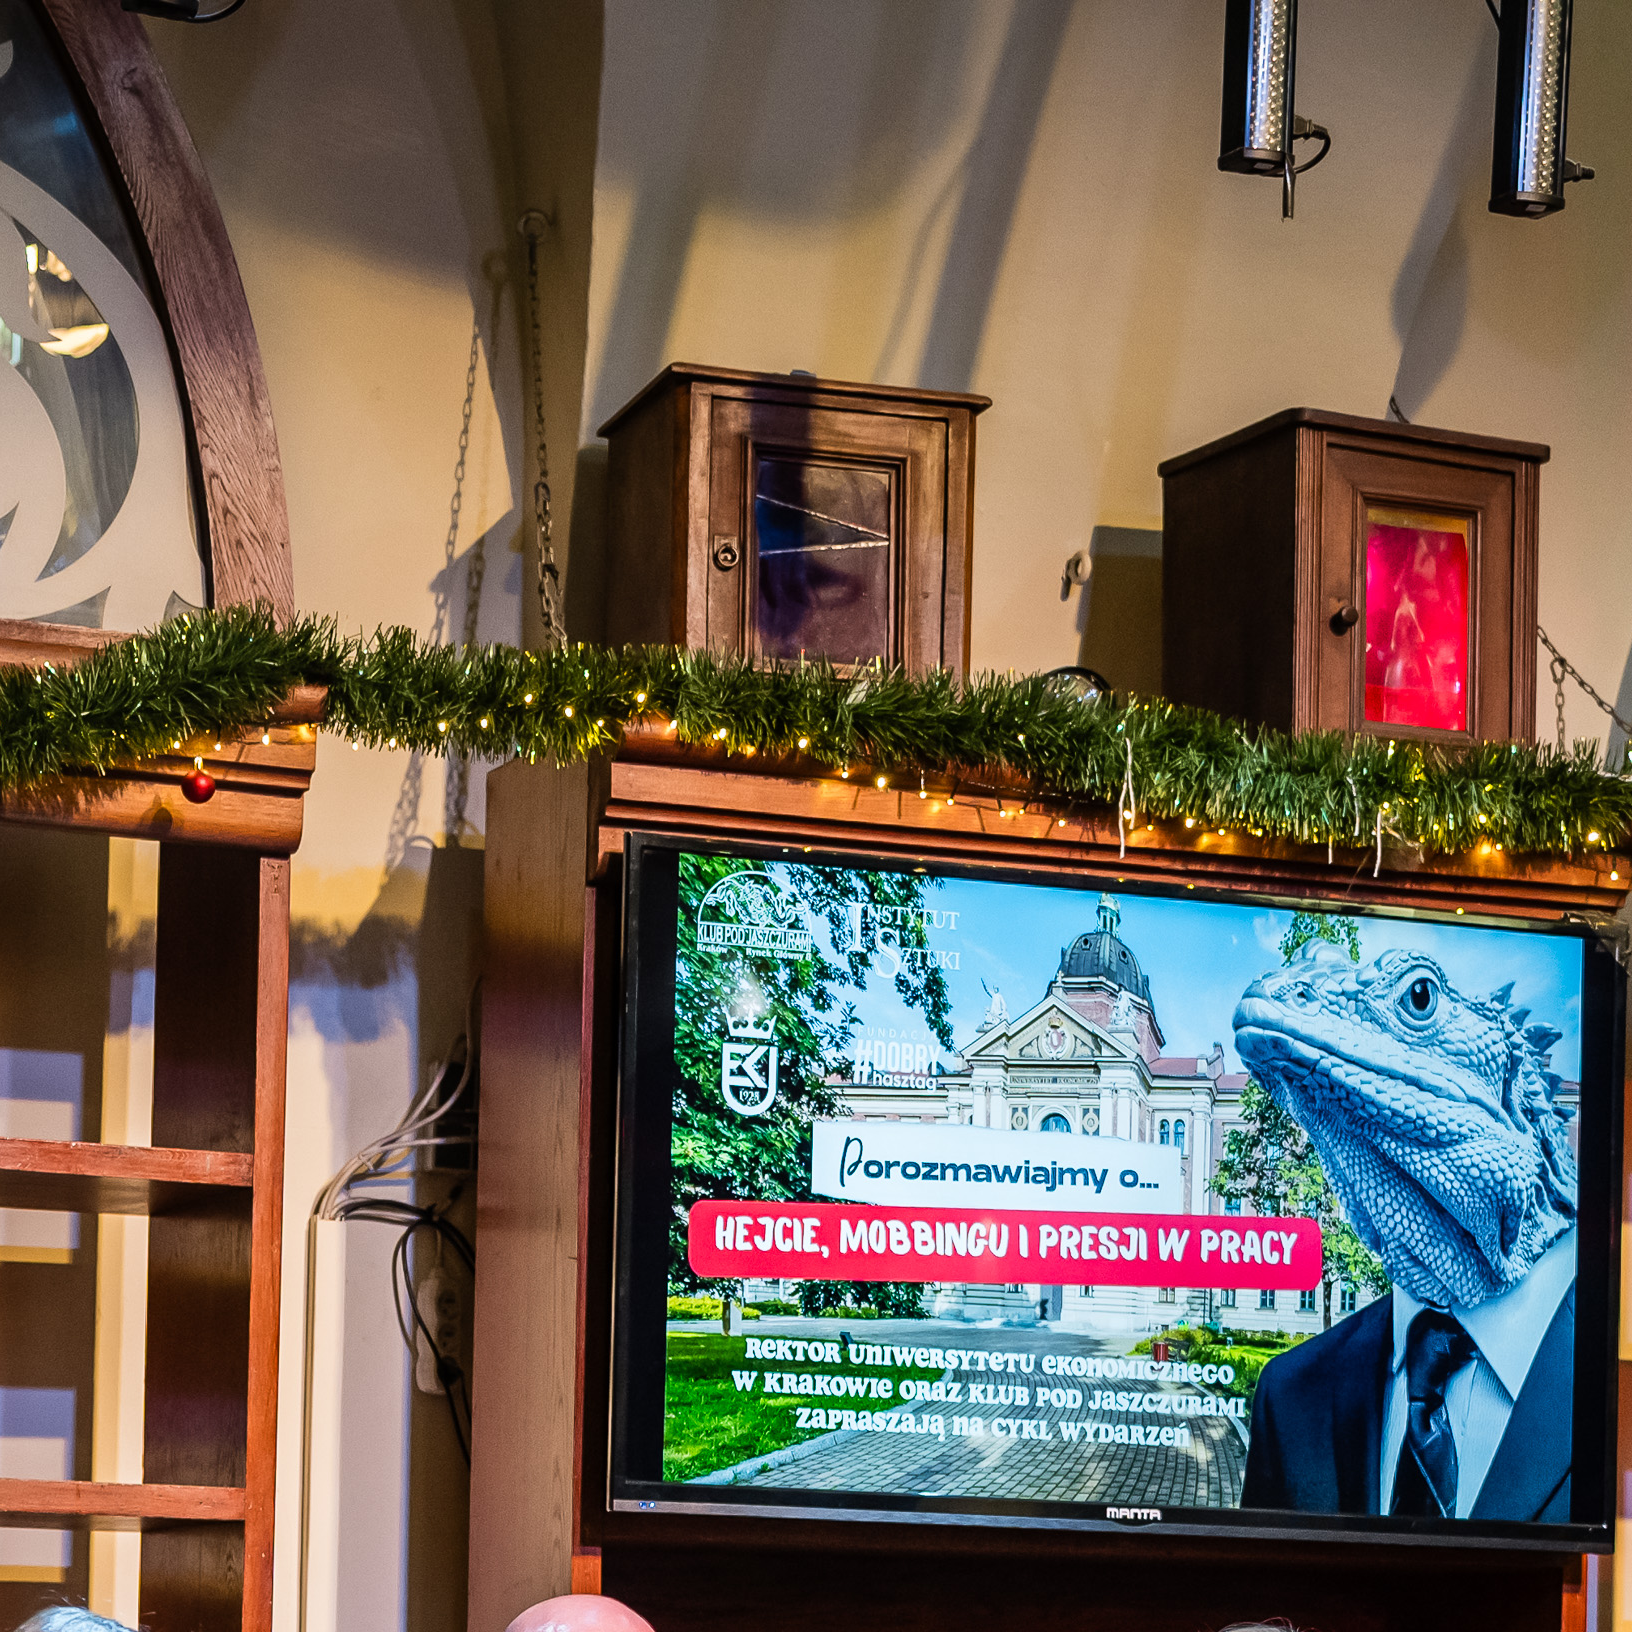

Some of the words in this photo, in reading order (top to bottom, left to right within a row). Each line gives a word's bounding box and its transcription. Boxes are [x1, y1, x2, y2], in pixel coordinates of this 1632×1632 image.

[697, 925, 723, 942] KLUB
[724, 927, 745, 944] POD
[746, 929, 811, 950] JASZCZURAMI
[850, 902, 960, 952] INSTYTUT
[874, 927, 961, 979] SZTUKI
[857, 1026, 939, 1040] FUNDACJA
[839, 1136, 1109, 1194] Porozmawiajmy
[1119, 1169, 1160, 1190] o...
[715, 1214, 830, 1259] HEJCIE,
[839, 1218, 1009, 1258] MOBBINGU
[1019, 1224, 1029, 1258] I
[1038, 1224, 1148, 1262] PRESJI
[1158, 1228, 1191, 1263] W
[1200, 1229, 1298, 1265] PRACY
[731, 1370, 758, 1392] W
[968, 1383, 1030, 1407] KLUB
[1035, 1387, 1083, 1409] POD
[991, 1418, 1053, 1441] CYKL
[1106, 1506, 1163, 1521] MANTA
